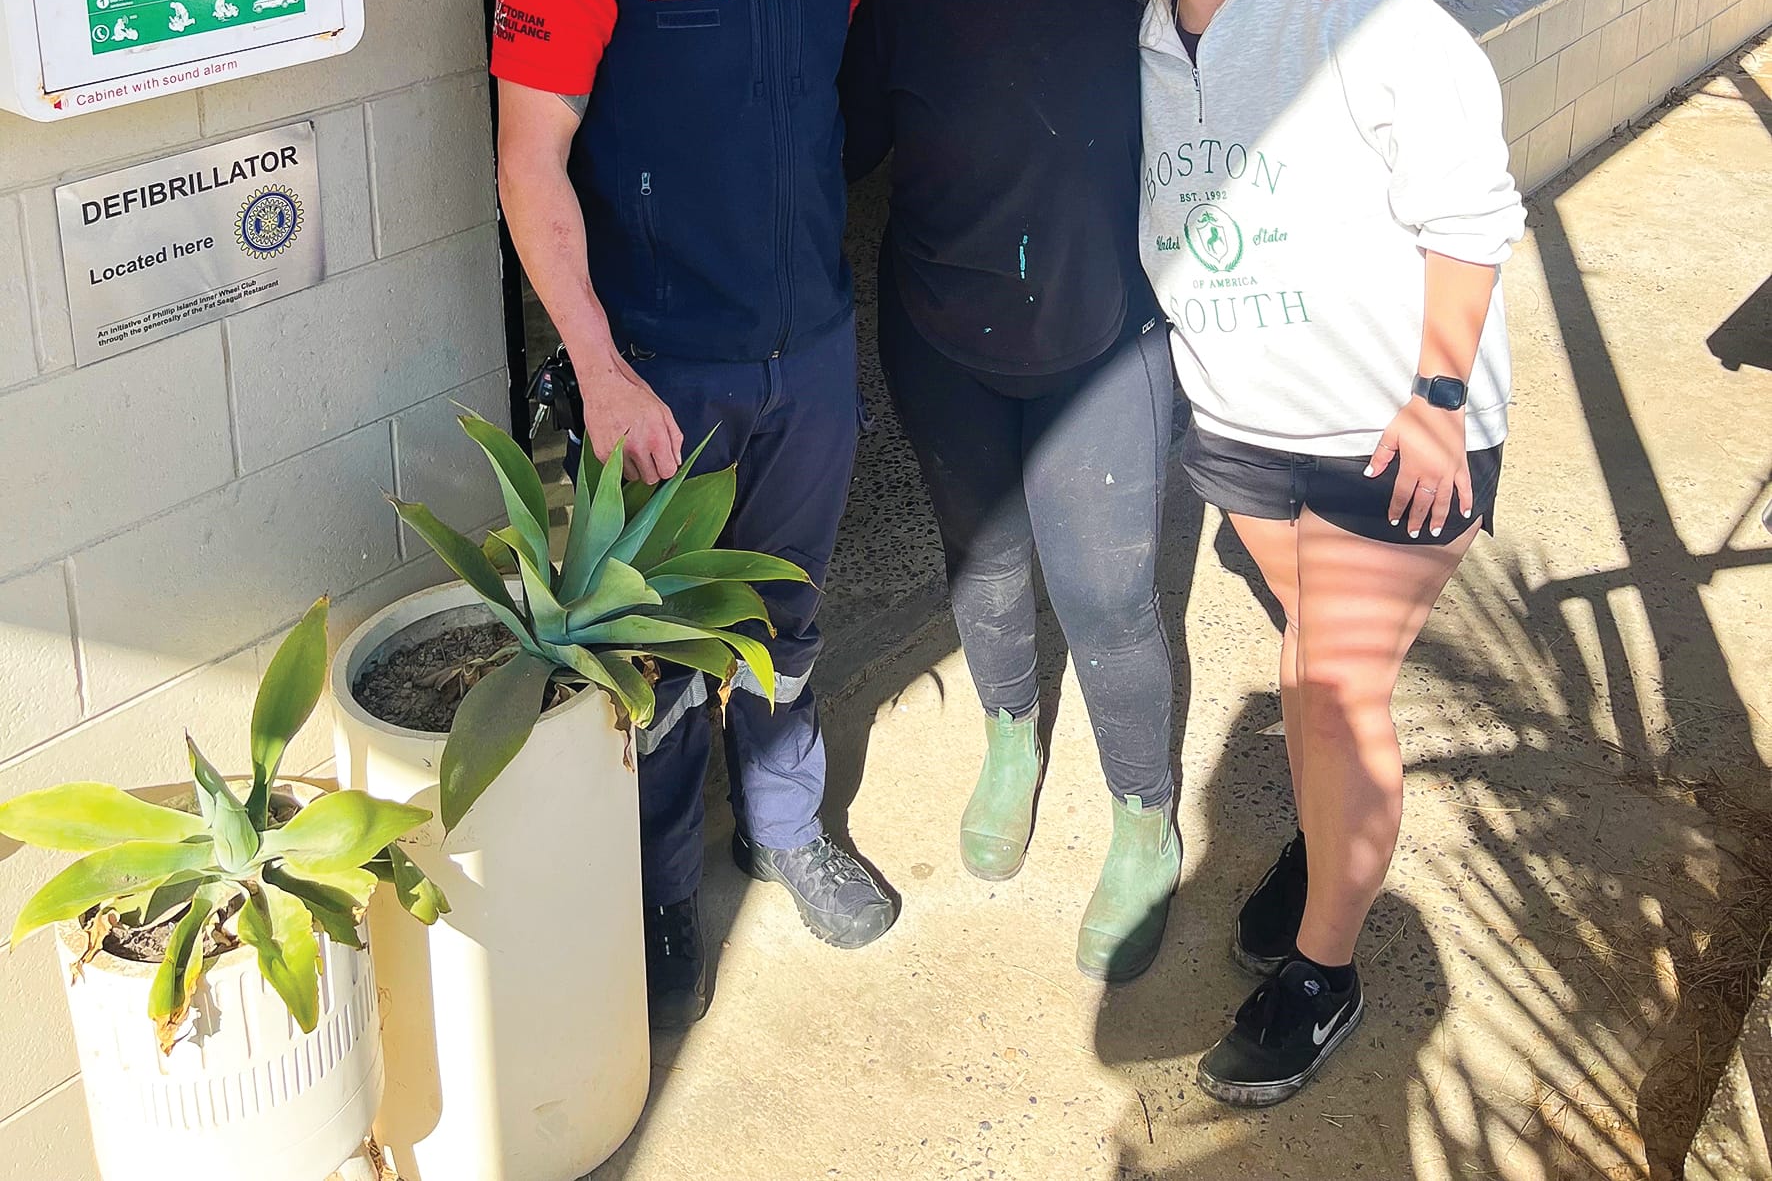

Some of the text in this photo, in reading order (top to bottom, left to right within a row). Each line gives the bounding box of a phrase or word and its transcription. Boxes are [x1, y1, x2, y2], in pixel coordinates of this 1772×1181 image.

[76, 59, 238, 106] Cabinet with sound alarm
[81, 145, 299, 226] DEFIBRILLATOR
[1145, 139, 1287, 206] BOSTON
[1205, 190, 1228, 201] 1992
[89, 236, 214, 285] Located here
[1252, 227, 1288, 246] States
[1192, 279, 1204, 290] OF
[97, 330, 109, 339] An
[143, 314, 151, 323] of
[152, 307, 176, 320] Phillip
[176, 299, 198, 312] Island
[199, 293, 218, 304] Inner
[218, 285, 240, 297] Wheel
[240, 280, 257, 290] Club
[98, 279, 279, 346] through the generosity of the Fat Seagull Restaurant
[1170, 290, 1312, 334] SOUTH
